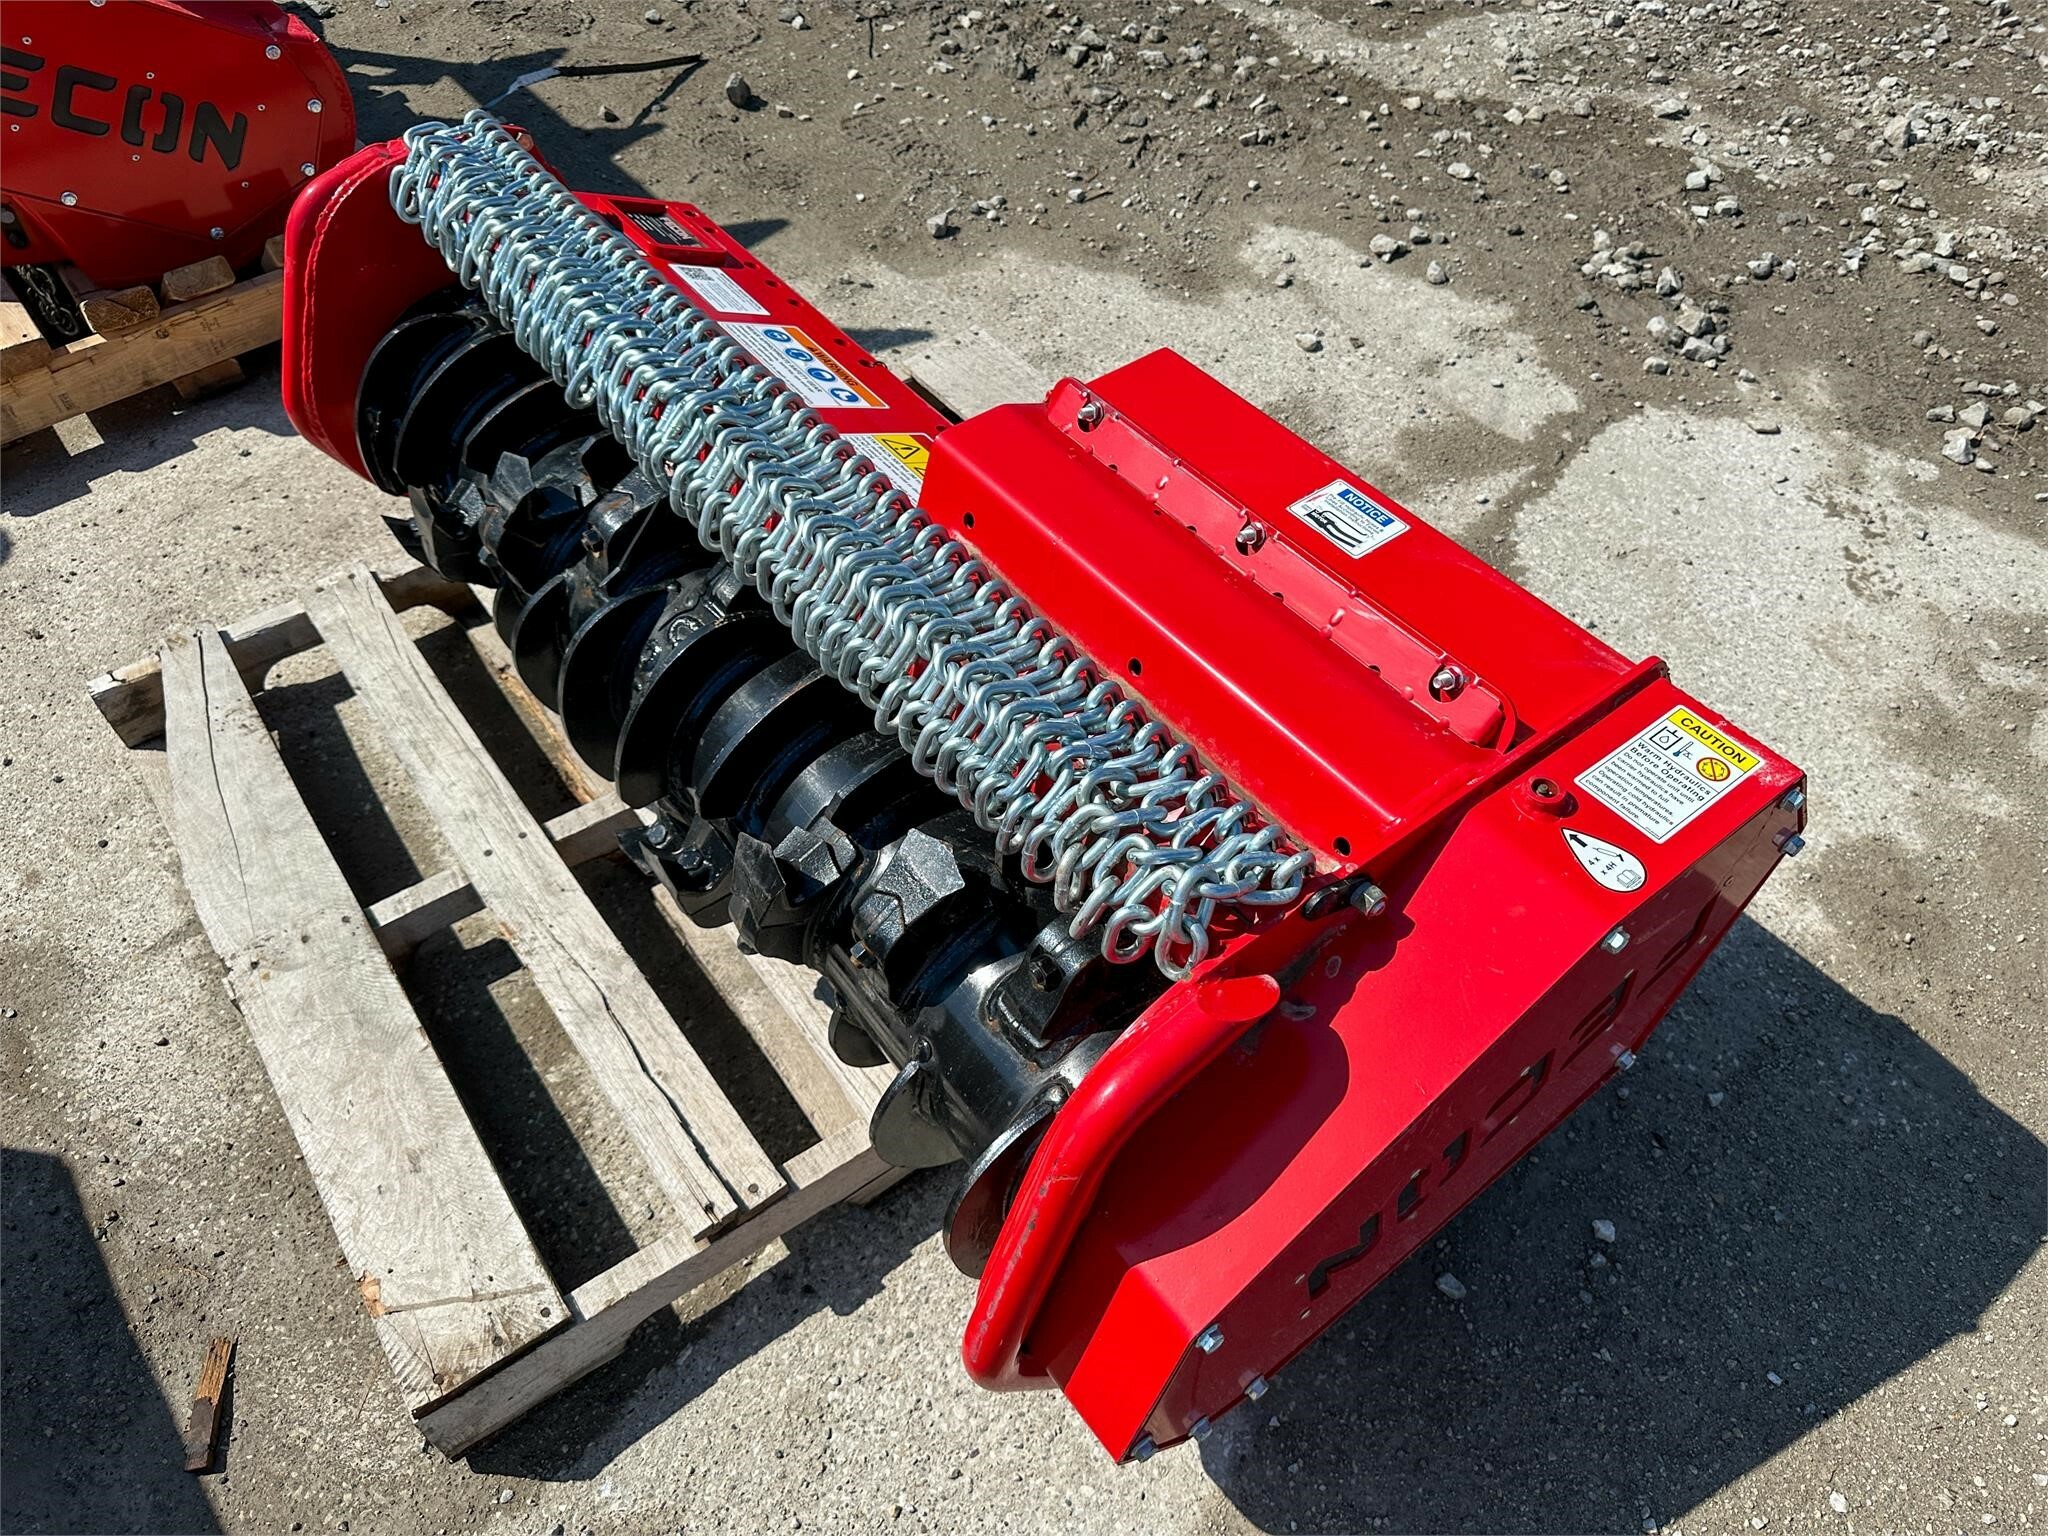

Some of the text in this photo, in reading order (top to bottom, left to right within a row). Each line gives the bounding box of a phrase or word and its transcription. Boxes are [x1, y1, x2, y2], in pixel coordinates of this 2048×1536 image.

[811, 351, 858, 386] WARNING
[1311, 512, 1328, 524] MOTOR
[1345, 493, 1388, 523] NOTICE
[1681, 718, 1747, 764] CAUTION
[1605, 766, 1673, 816] operation temperatures.
[1611, 761, 1626, 773] been
[1627, 772, 1651, 790] warmed
[1658, 794, 1670, 803] full
[1617, 757, 1684, 805] carrier hydraulics have
[1624, 752, 1695, 803] Do not operate unit until
[1630, 747, 1705, 802] Before Operating
[1638, 742, 1711, 795] Warm Hydraulics
[1585, 780, 1639, 819] component failure.
[1592, 775, 1604, 784] can
[1604, 784, 1622, 797] result
[1628, 801, 1660, 824] premature
[1598, 770, 1674, 826] Operating cold hydraulics
[1588, 858, 1595, 866] 4
[1605, 861, 1617, 872] 4H
